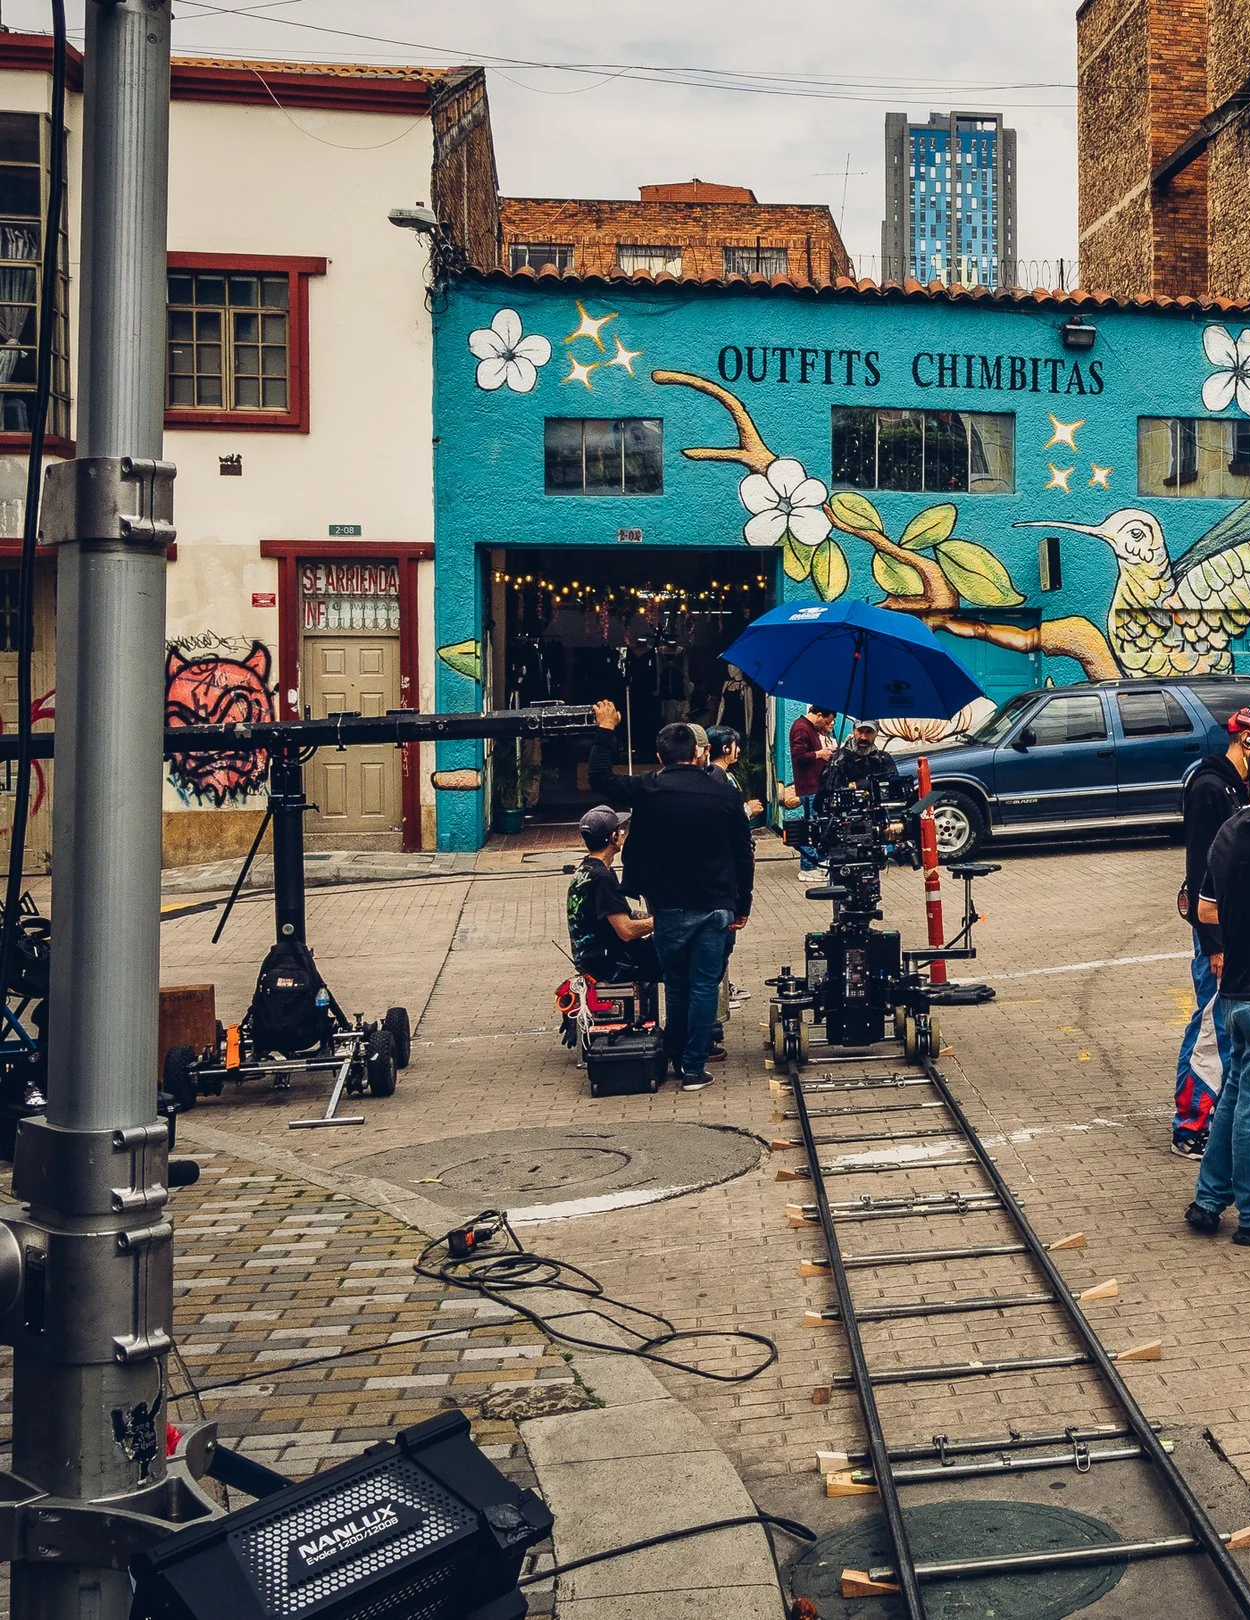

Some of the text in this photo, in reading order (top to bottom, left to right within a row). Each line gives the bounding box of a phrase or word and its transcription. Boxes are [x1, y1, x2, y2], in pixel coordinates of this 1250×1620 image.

[717, 345, 1104, 395] OUTFITS CHIMBITAS
[335, 526, 355, 535] 2-08
[303, 565, 399, 592] SE ARRIENDA
[298, 1503, 397, 1559] NANLUX
[305, 1516, 399, 1566] Evoke 1200/1200B
